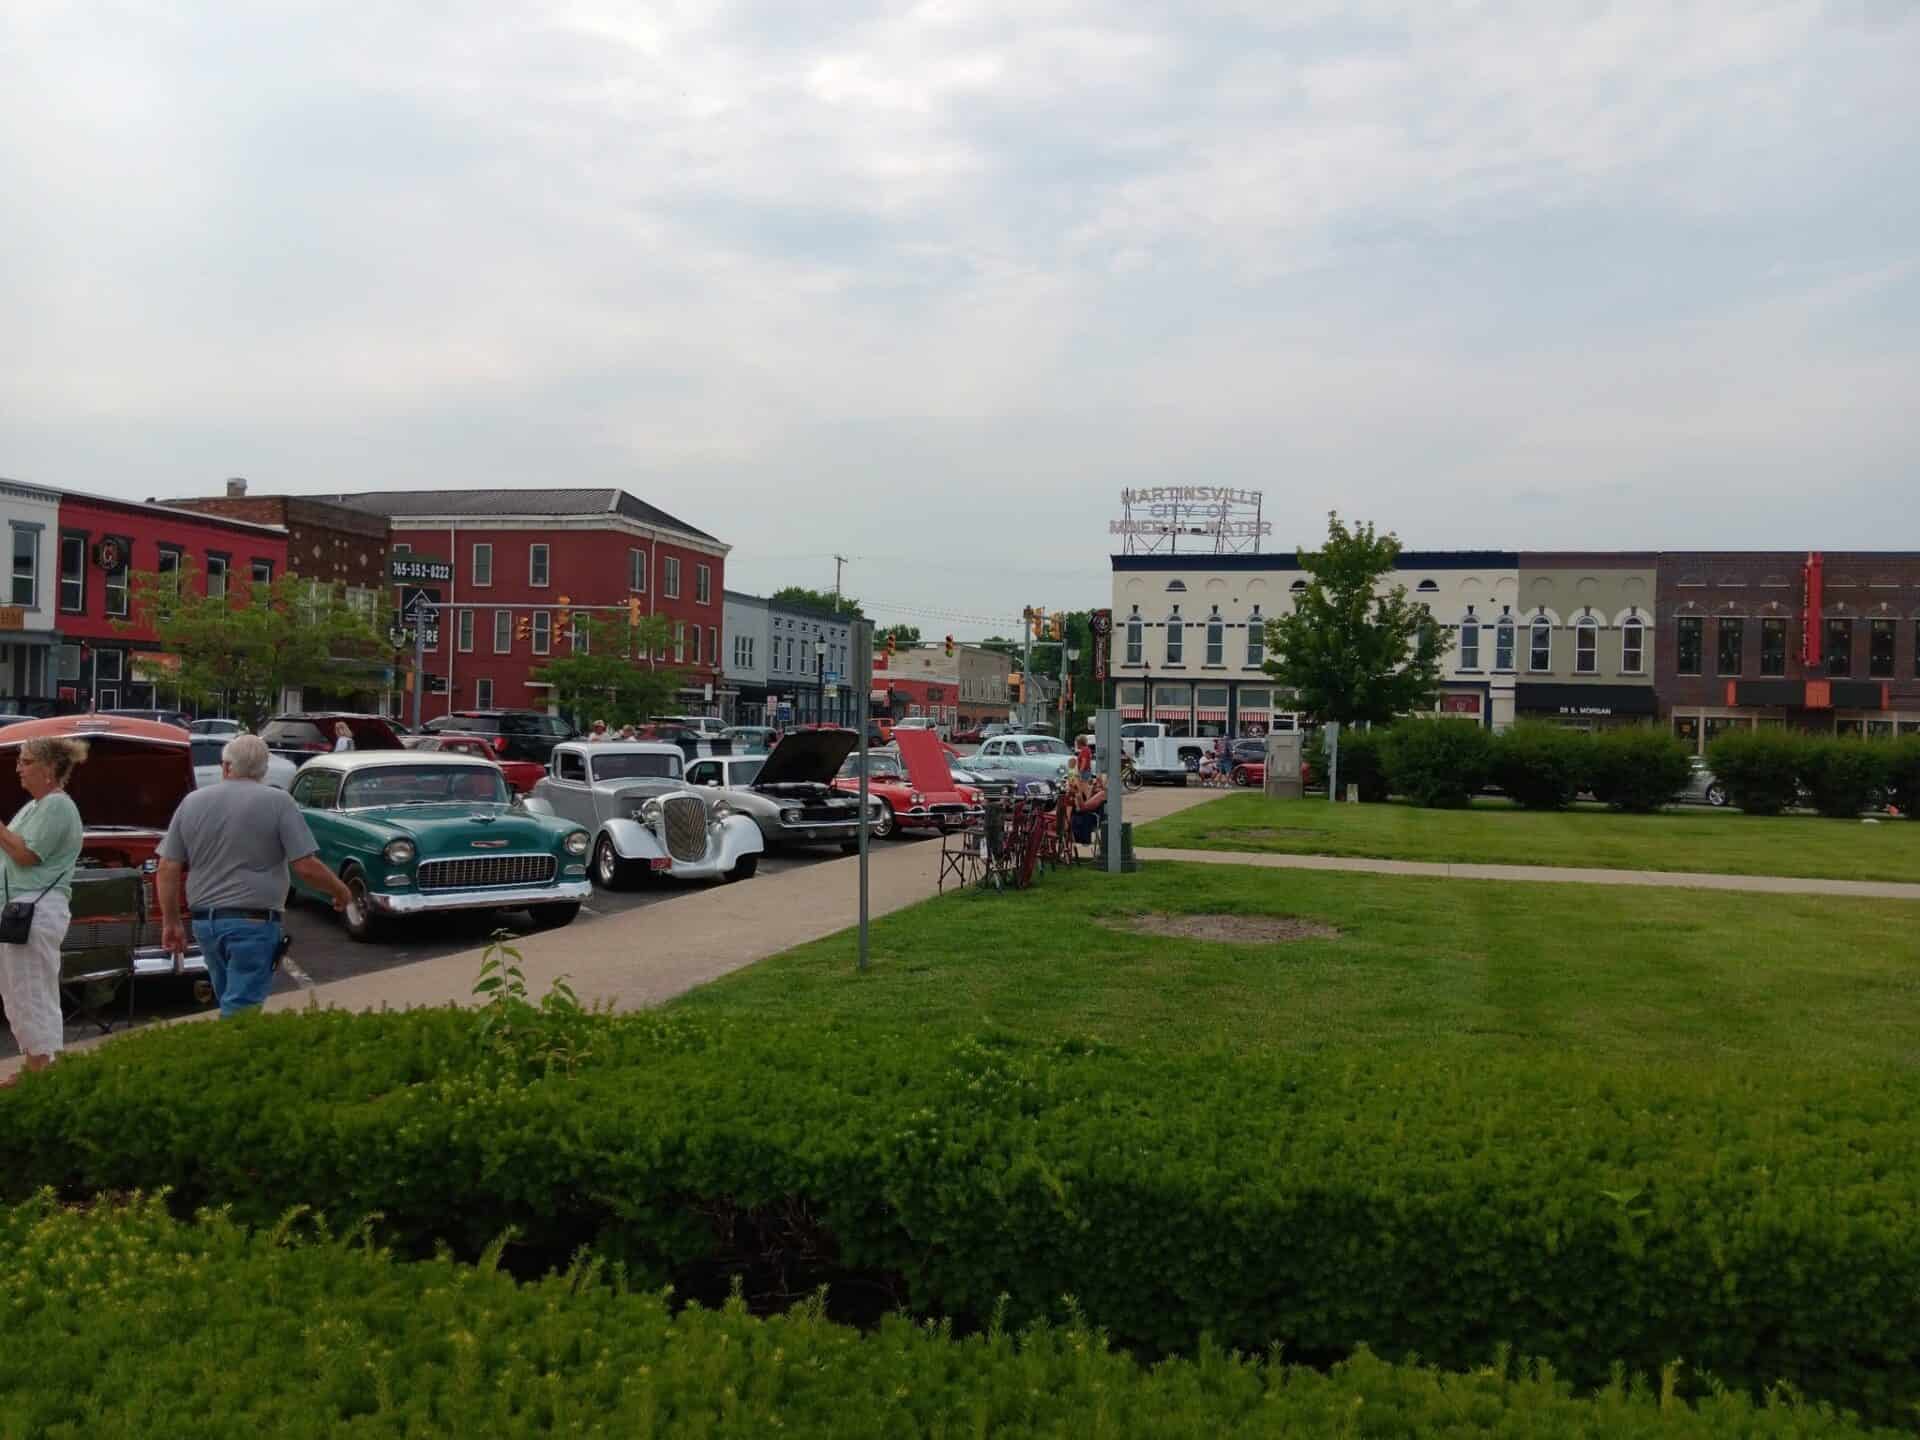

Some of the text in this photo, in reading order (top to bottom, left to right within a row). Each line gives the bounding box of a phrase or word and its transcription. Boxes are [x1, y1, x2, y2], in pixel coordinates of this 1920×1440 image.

[1121, 486, 1262, 505] MARTINSVILLE
[1150, 503, 1233, 518] CITY OF
[1109, 519, 1273, 537] MINERAL WATER
[390, 627, 408, 642] ET
